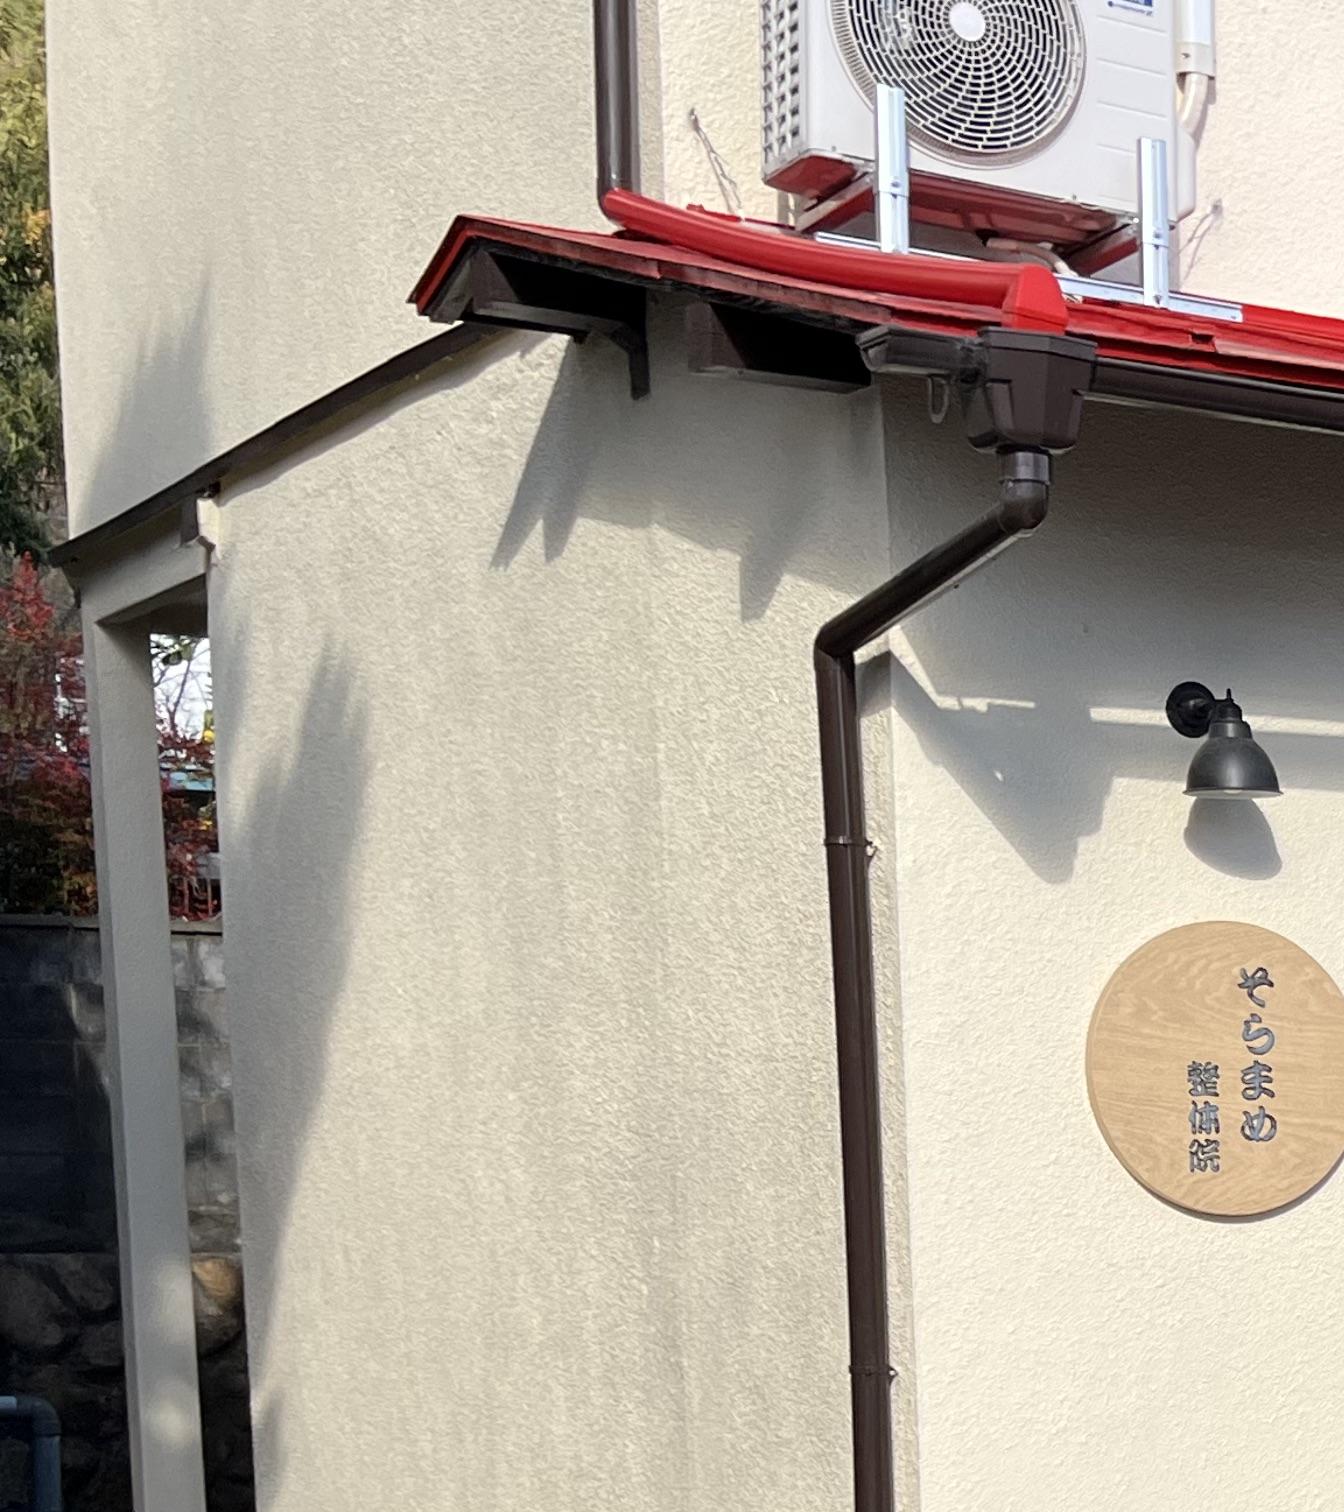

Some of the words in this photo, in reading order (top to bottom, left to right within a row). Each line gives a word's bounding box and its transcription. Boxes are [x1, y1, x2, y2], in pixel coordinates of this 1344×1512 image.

[1187, 1060, 1220, 1173] 整体院
[1238, 967, 1277, 1142] そらまめ
